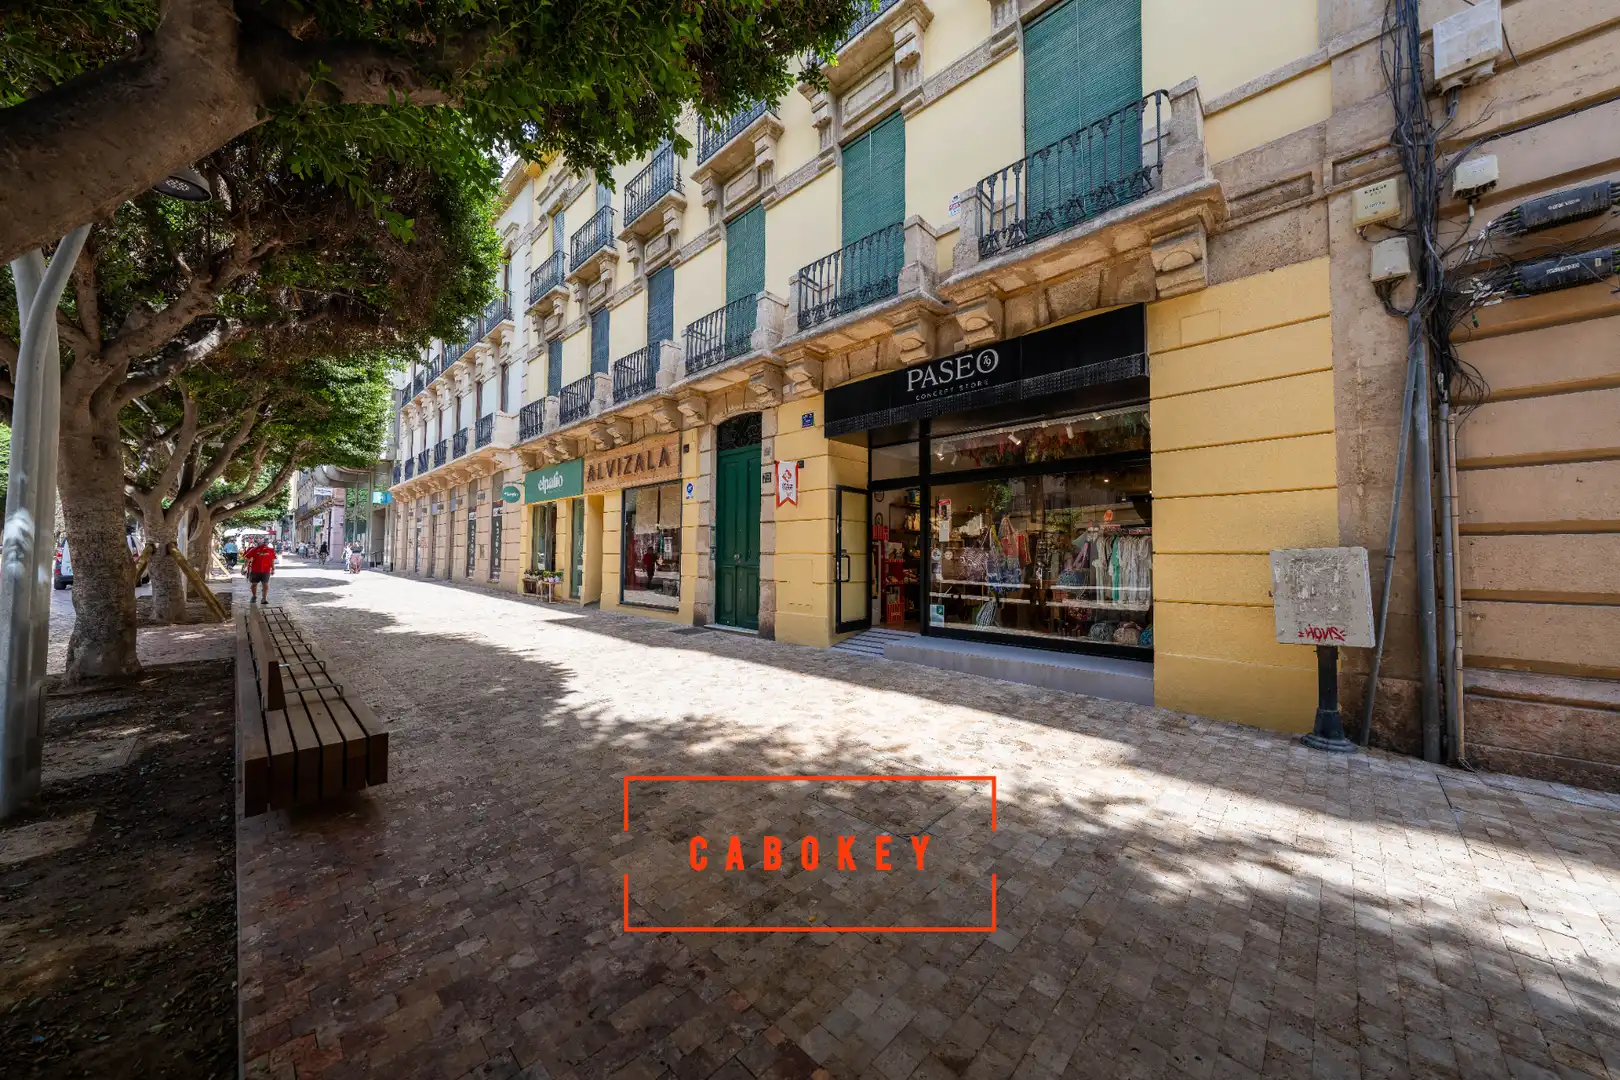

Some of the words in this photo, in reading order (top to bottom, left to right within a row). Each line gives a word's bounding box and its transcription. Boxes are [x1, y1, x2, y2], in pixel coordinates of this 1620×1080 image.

[907, 349, 999, 392] PASEO
[915, 386, 954, 401] CONCEPT
[959, 379, 989, 391] STORE
[587, 447, 670, 481] ALVIZALA
